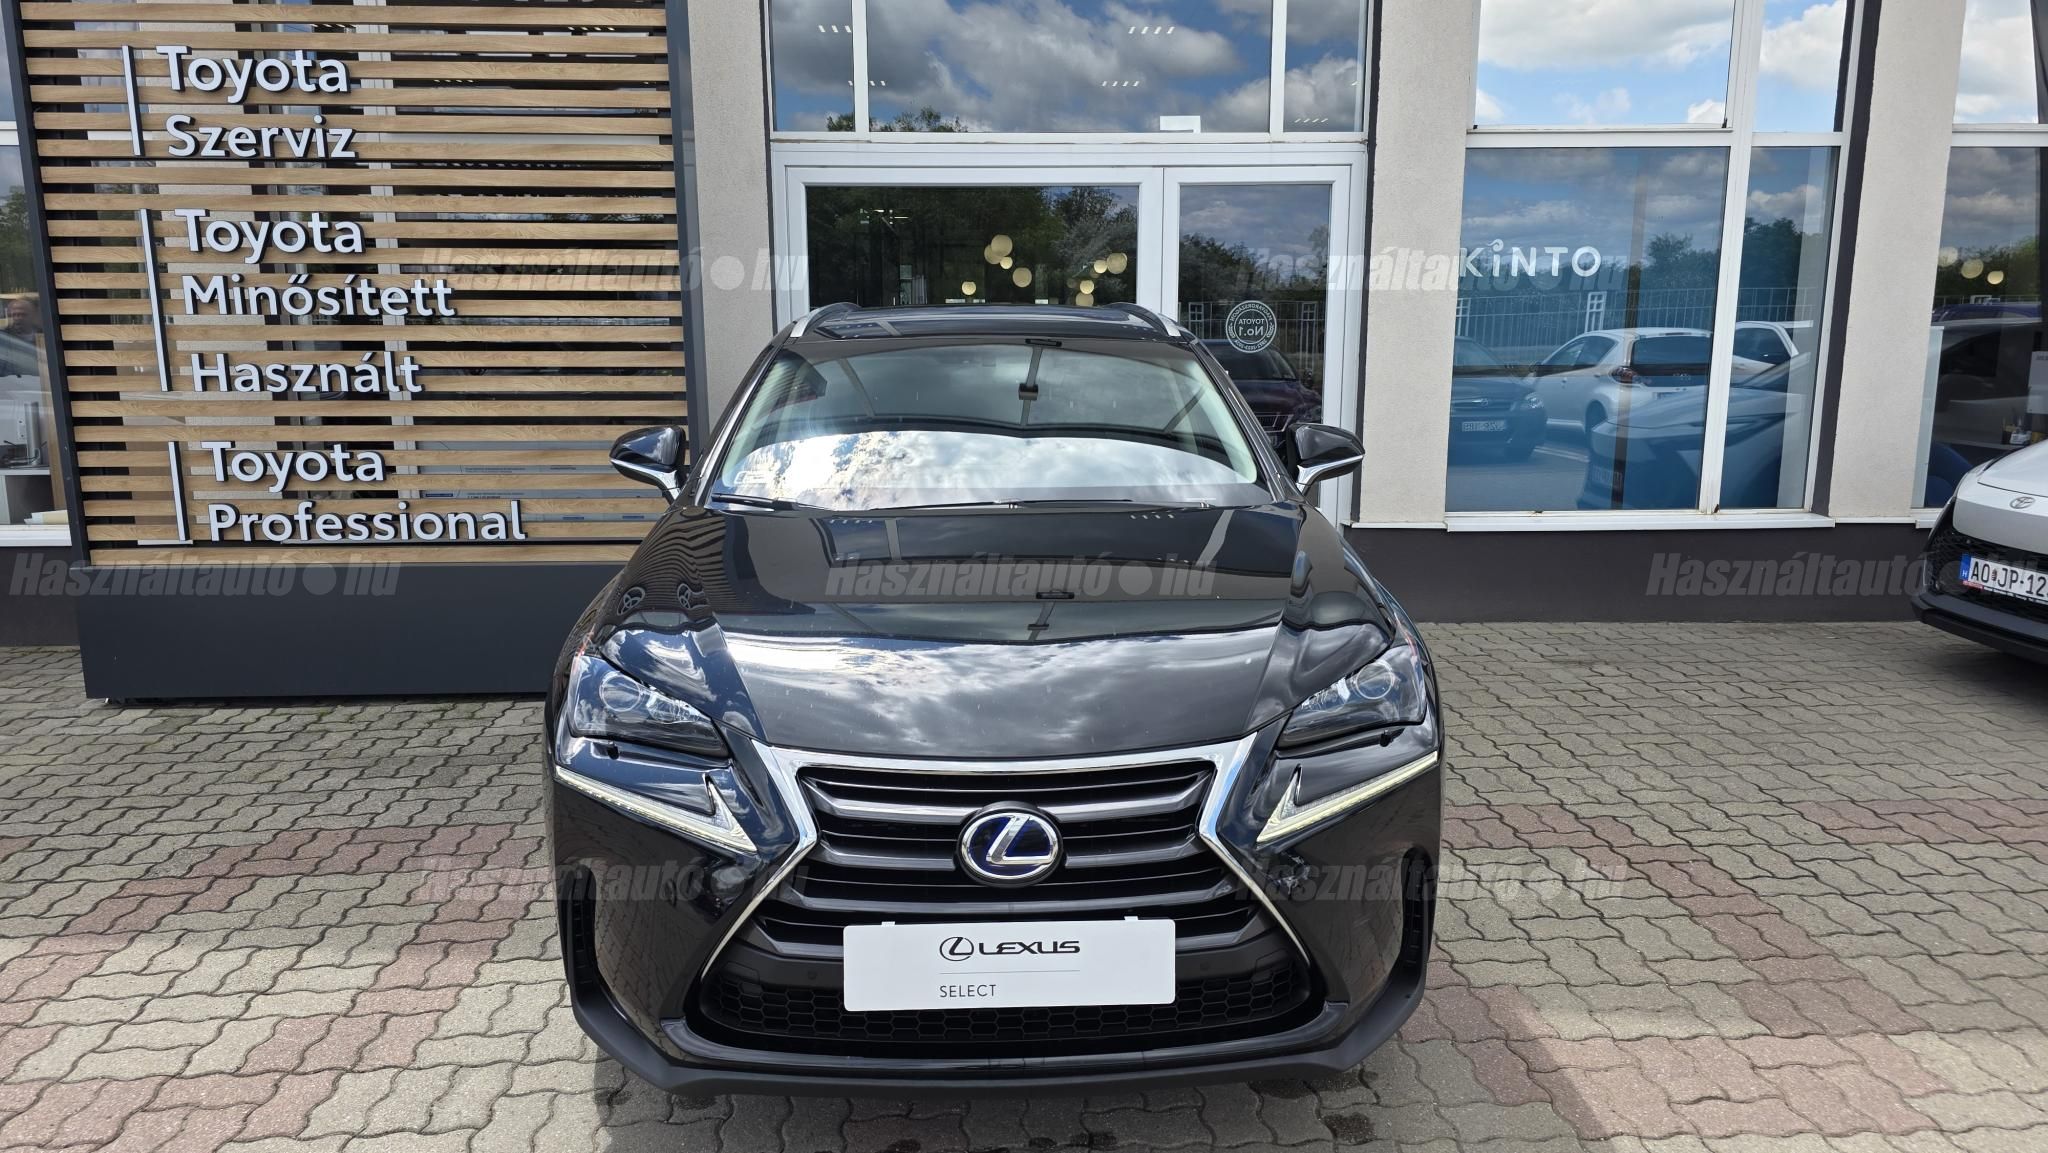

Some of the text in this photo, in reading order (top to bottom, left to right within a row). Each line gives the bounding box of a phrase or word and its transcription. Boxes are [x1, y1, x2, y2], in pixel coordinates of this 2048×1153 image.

[156, 45, 350, 104] Toyota
[165, 114, 358, 159] Szerviz
[175, 208, 365, 264] Toyota
[181, 273, 455, 317] Minősített
[191, 352, 424, 394] Használt
[202, 441, 387, 492] Toyota
[208, 501, 527, 542] Professional
[1998, 568, 2048, 598] JP-12
[978, 941, 1081, 956] LEXUS
[939, 984, 997, 998] SELECT
